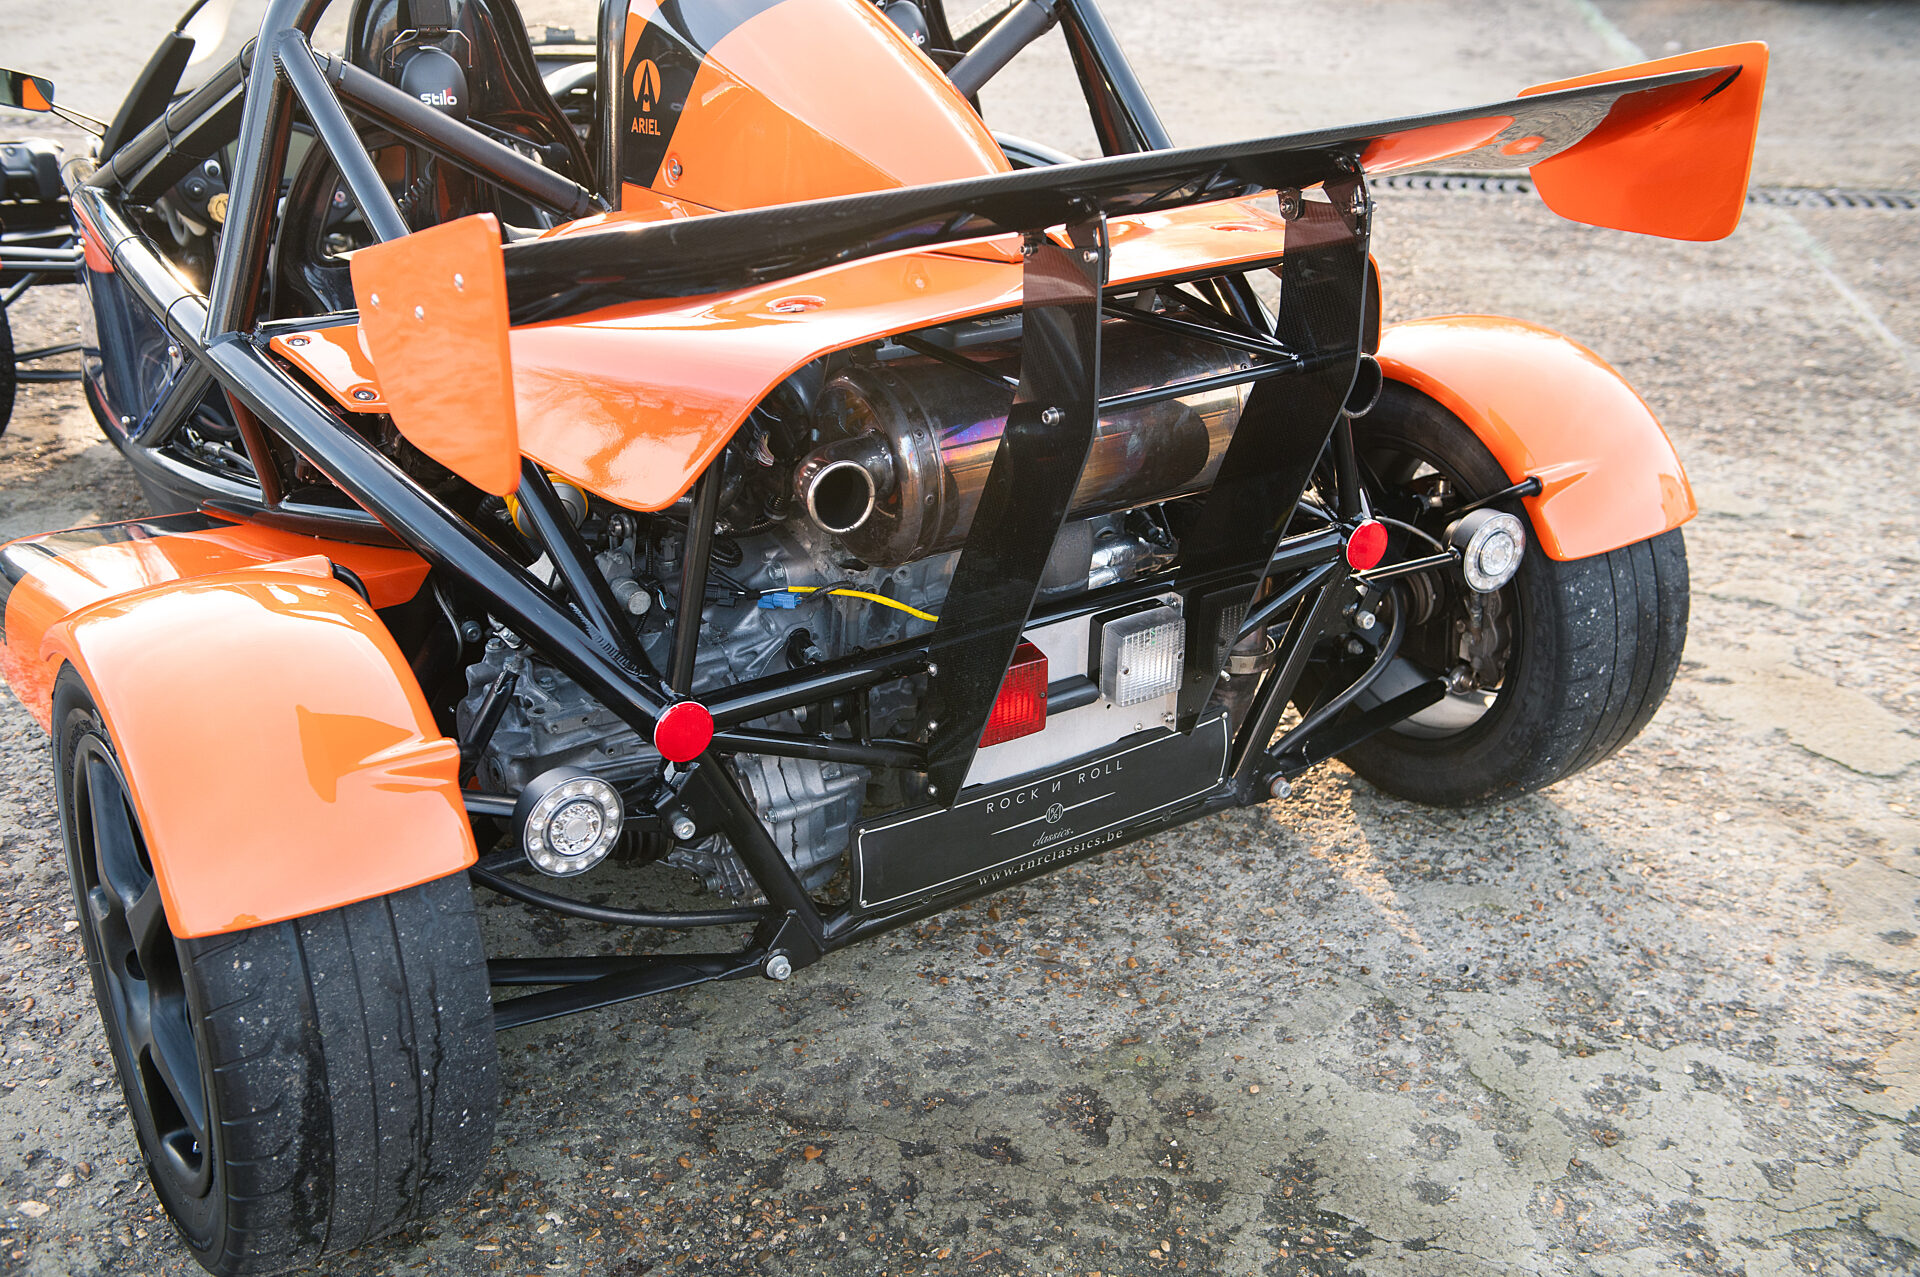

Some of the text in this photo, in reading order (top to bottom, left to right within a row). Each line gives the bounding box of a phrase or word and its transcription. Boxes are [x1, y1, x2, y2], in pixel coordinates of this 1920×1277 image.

[420, 87, 457, 105] Stilo
[631, 117, 661, 135] ARIEL
[986, 788, 1039, 814] ROCK
[1078, 760, 1122, 784] ROLL
[977, 829, 1123, 886] www.rnrclassics.be
